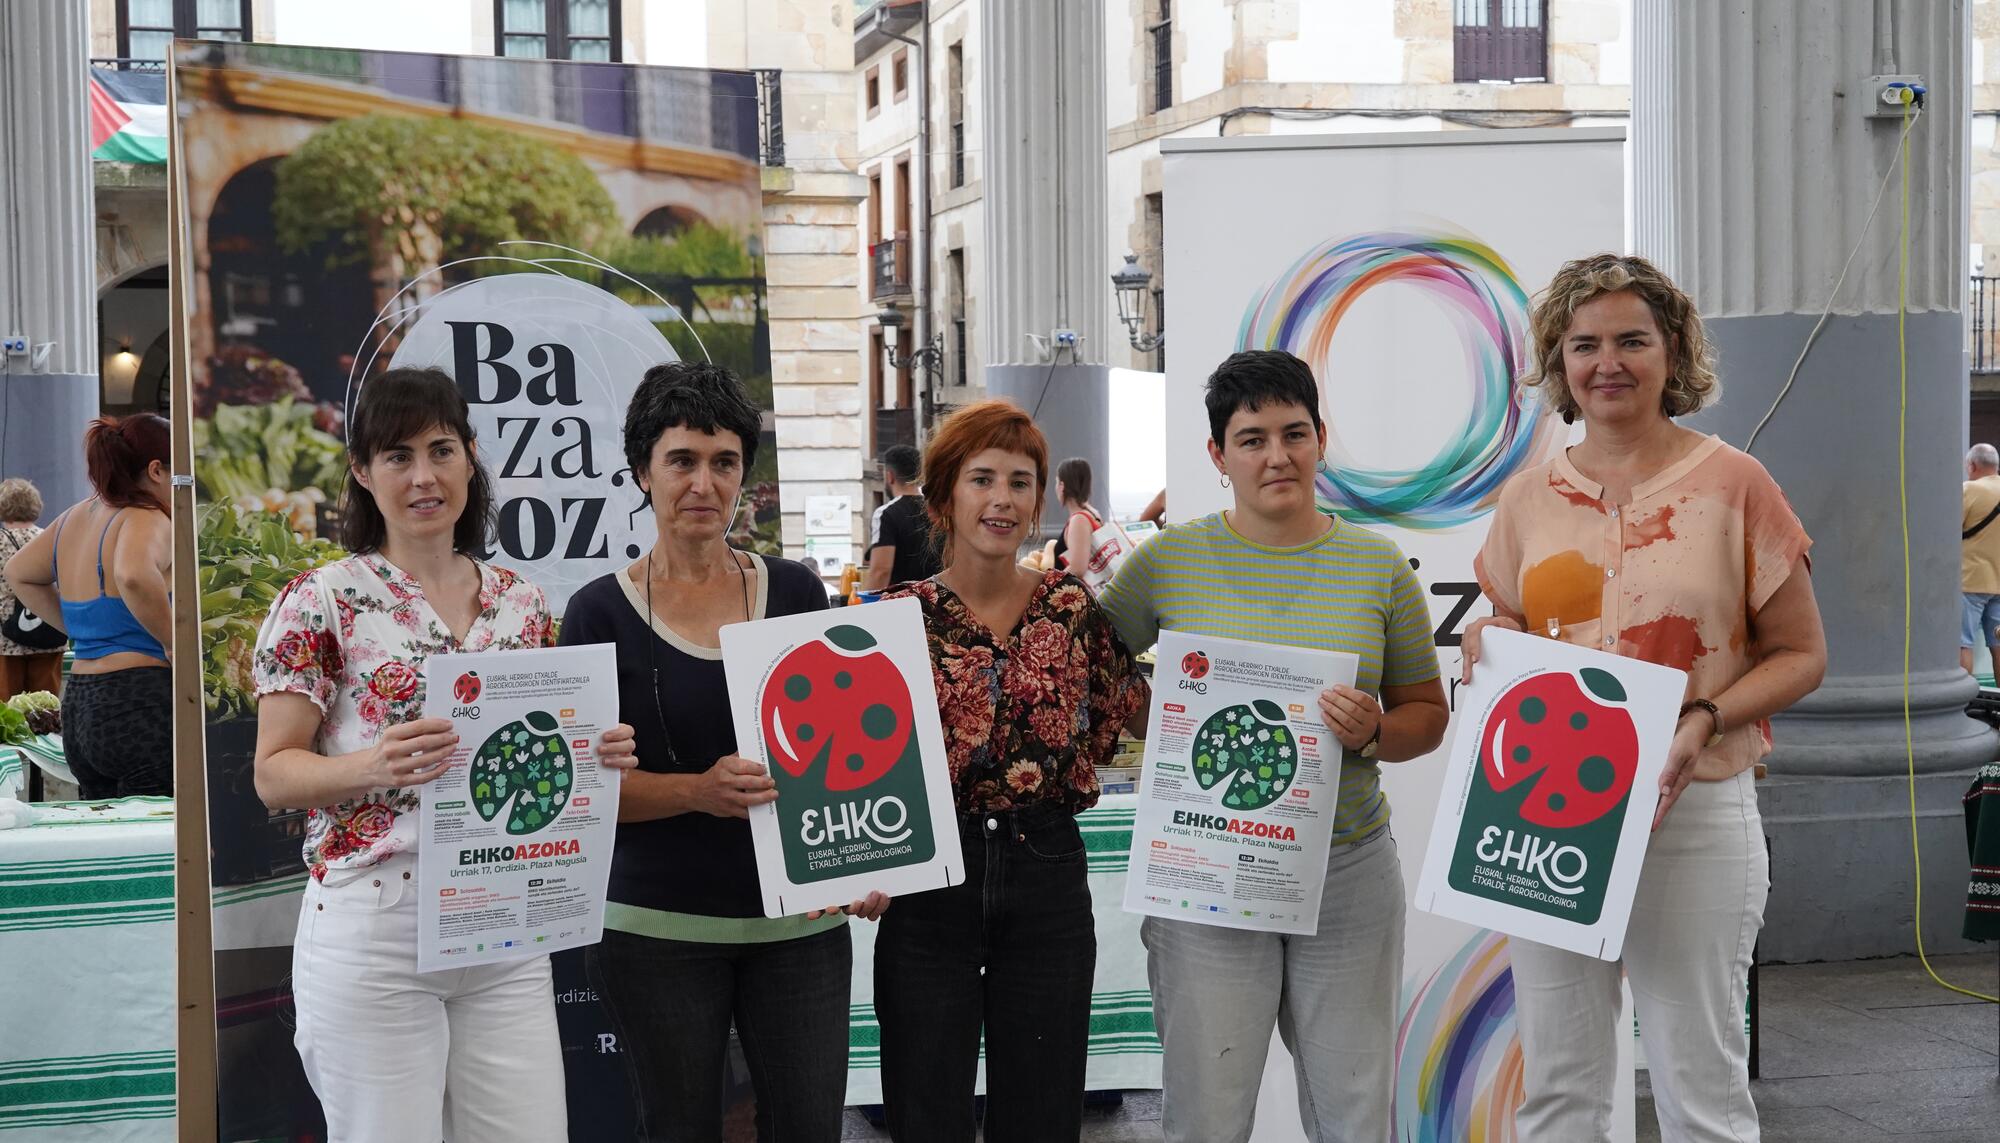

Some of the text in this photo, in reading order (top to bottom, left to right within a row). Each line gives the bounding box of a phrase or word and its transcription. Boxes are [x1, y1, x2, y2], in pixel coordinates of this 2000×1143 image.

[444, 321, 583, 406] Ba
[497, 416, 602, 479] za
[478, 468, 652, 562] oz?
[486, 671, 558, 682] EUSKAL HERRIKO ETXALDE
[1214, 658, 1290, 673] EUSKAL HERRIKO ETXALDE
[1214, 665, 1270, 678] AGROEKOLOGIKOEN
[1271, 671, 1324, 686] IDENTIFIKATZAILEA
[486, 676, 590, 690] AGROEKOLOGIKOEN IDENTIFIKATZAILEA
[1179, 680, 1207, 695] EHKO
[452, 706, 481, 720] EHKO
[800, 795, 913, 846] EHKO
[1173, 810, 1295, 841] EHKOAZOKA
[808, 842, 872, 861] EUSKAL HERRIKO
[1163, 825, 1191, 837] Urriak
[1242, 837, 1266, 848] Plaza
[1268, 841, 1302, 853] Nagusia
[459, 839, 580, 866] EHKOAZOKA
[809, 845, 912, 871] ETXALDE AGROEKOLOGIKOA
[1476, 825, 1588, 895] EHKO
[450, 865, 479, 878] Urriak
[530, 860, 553, 870] Plaza
[555, 856, 587, 868] Nagusia
[1475, 865, 1539, 889] EUSKAL HERRIKO
[1472, 875, 1577, 909] ETXALDE AGROEKOLOGIKOA
[556, 988, 600, 1004] rdizia
